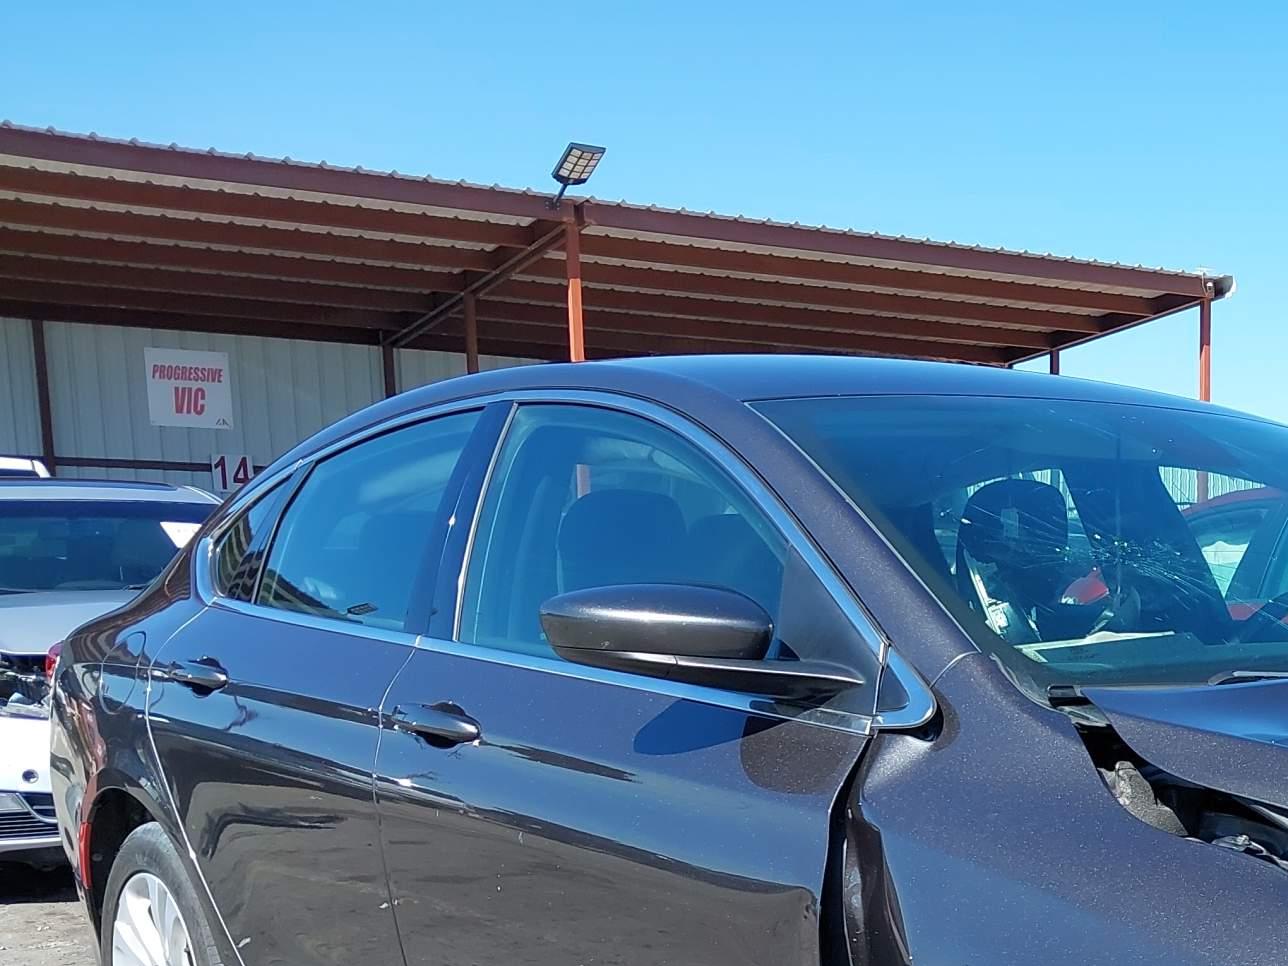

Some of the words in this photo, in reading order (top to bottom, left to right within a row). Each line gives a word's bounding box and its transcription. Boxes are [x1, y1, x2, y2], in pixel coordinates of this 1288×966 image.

[152, 363, 224, 384] PROGRESSIVE
[174, 386, 206, 416] VIC
[213, 455, 250, 490] 14
